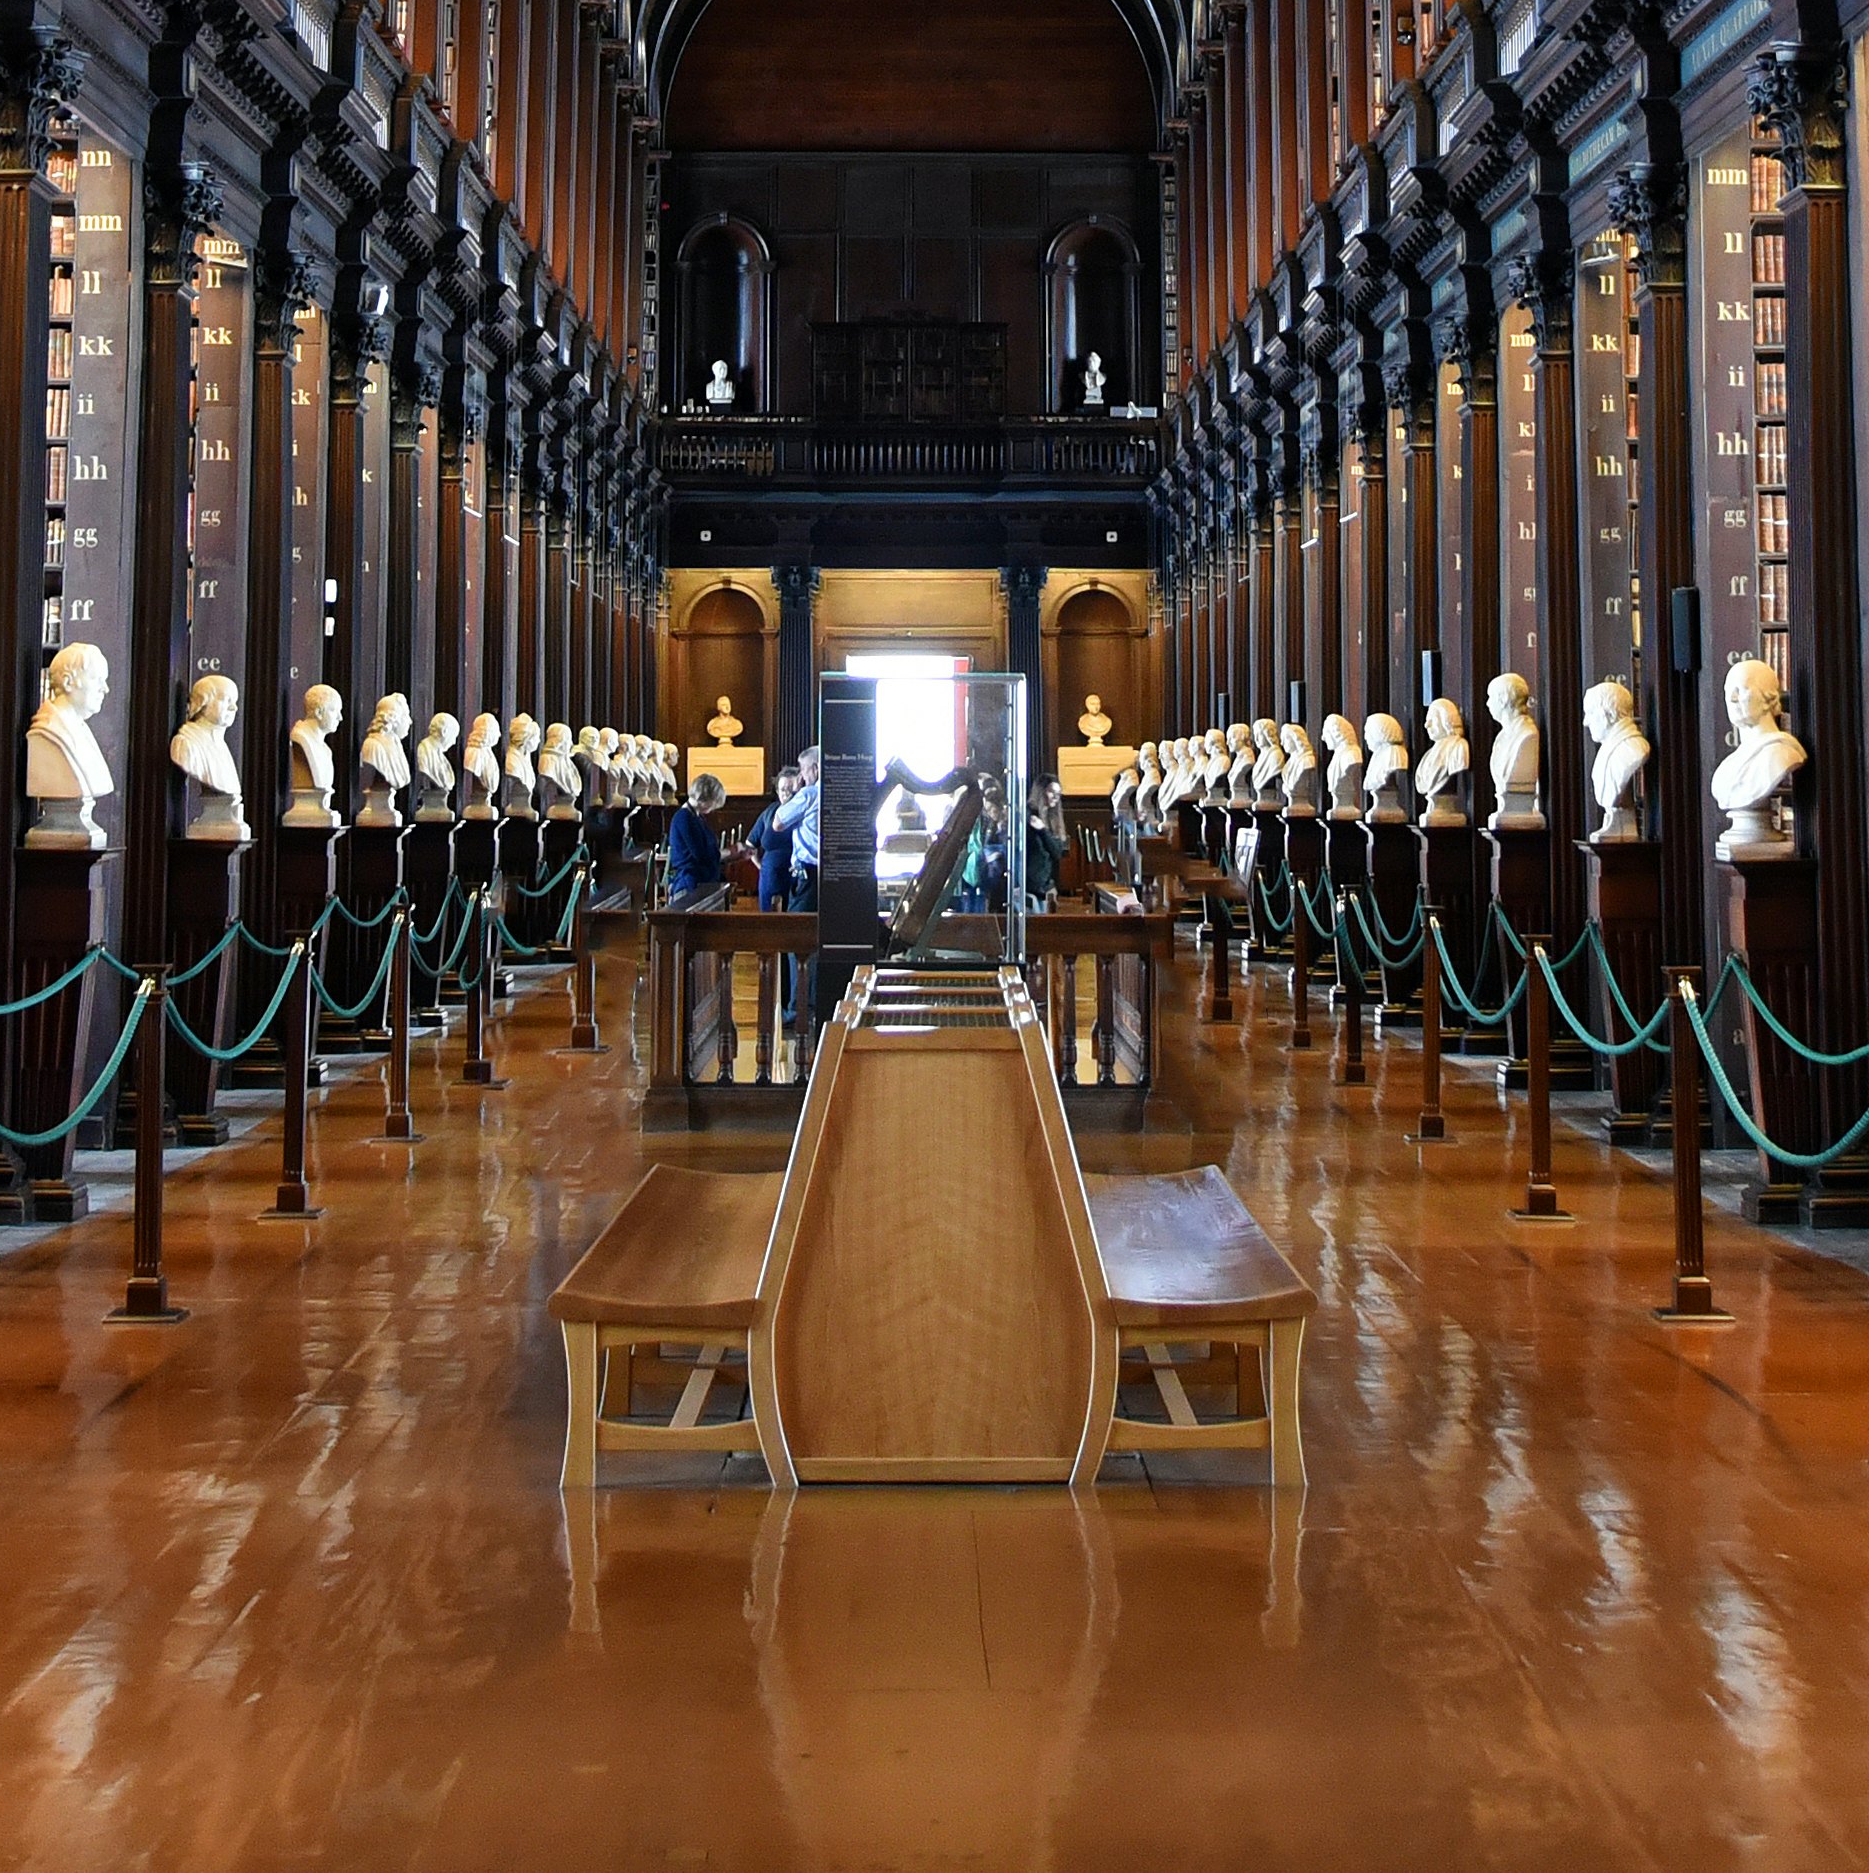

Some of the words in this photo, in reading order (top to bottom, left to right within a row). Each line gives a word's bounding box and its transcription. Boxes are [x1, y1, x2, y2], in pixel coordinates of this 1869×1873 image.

[81, 151, 111, 166] nn
[1708, 169, 1747, 184] mm
[79, 215, 122, 231] mm
[203, 240, 239, 254] mm
[1724, 233, 1743, 253] ll
[82, 271, 100, 294] ll
[206, 269, 221, 288] ll
[1600, 276, 1614, 294] ll
[1718, 302, 1750, 320] kk
[203, 327, 232, 344] kk
[1593, 335, 1618, 351] kk
[79, 336, 112, 355] kk
[1729, 366, 1745, 386] ii
[205, 383, 219, 401] ii
[78, 394, 94, 414] ii
[1602, 395, 1614, 412] ii
[202, 440, 229, 460] hh
[1717, 432, 1748, 455] hh
[74, 456, 107, 480] hh
[1597, 456, 1622, 475] hh
[201, 511, 220, 526] gg
[1724, 510, 1746, 527] gg
[74, 529, 97, 547] gg
[1601, 528, 1621, 541] gg
[200, 581, 218, 598] ff
[1731, 576, 1748, 595] ff
[70, 600, 93, 620] ff
[1606, 598, 1622, 614] ff
[198, 658, 220, 670] ee
